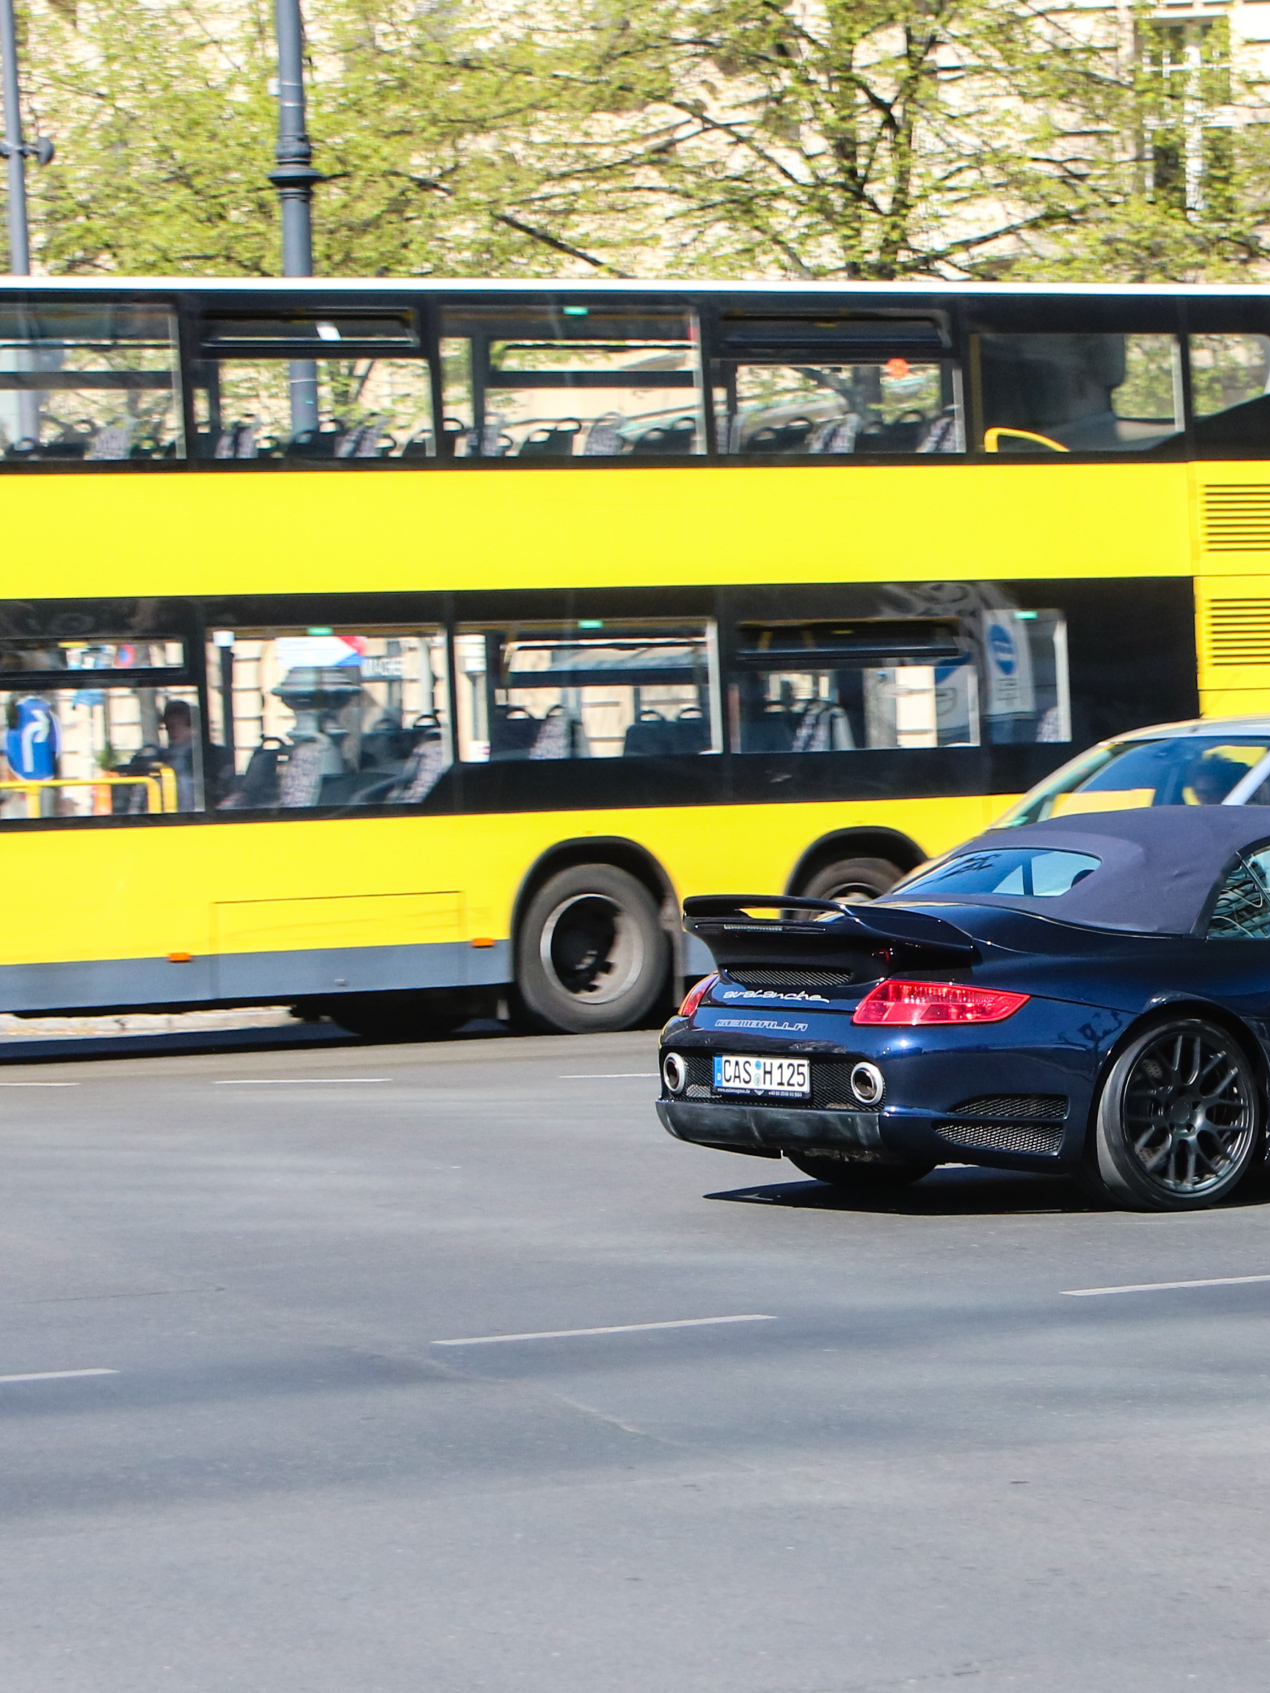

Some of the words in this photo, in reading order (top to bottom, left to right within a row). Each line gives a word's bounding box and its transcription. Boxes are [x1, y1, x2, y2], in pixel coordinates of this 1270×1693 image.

[723, 989, 830, 1003] avalanche
[715, 1019, 808, 1032] GEMBALLA
[723, 1059, 752, 1085] CAS
[763, 1062, 773, 1085] H
[777, 1062, 806, 1088] 125
